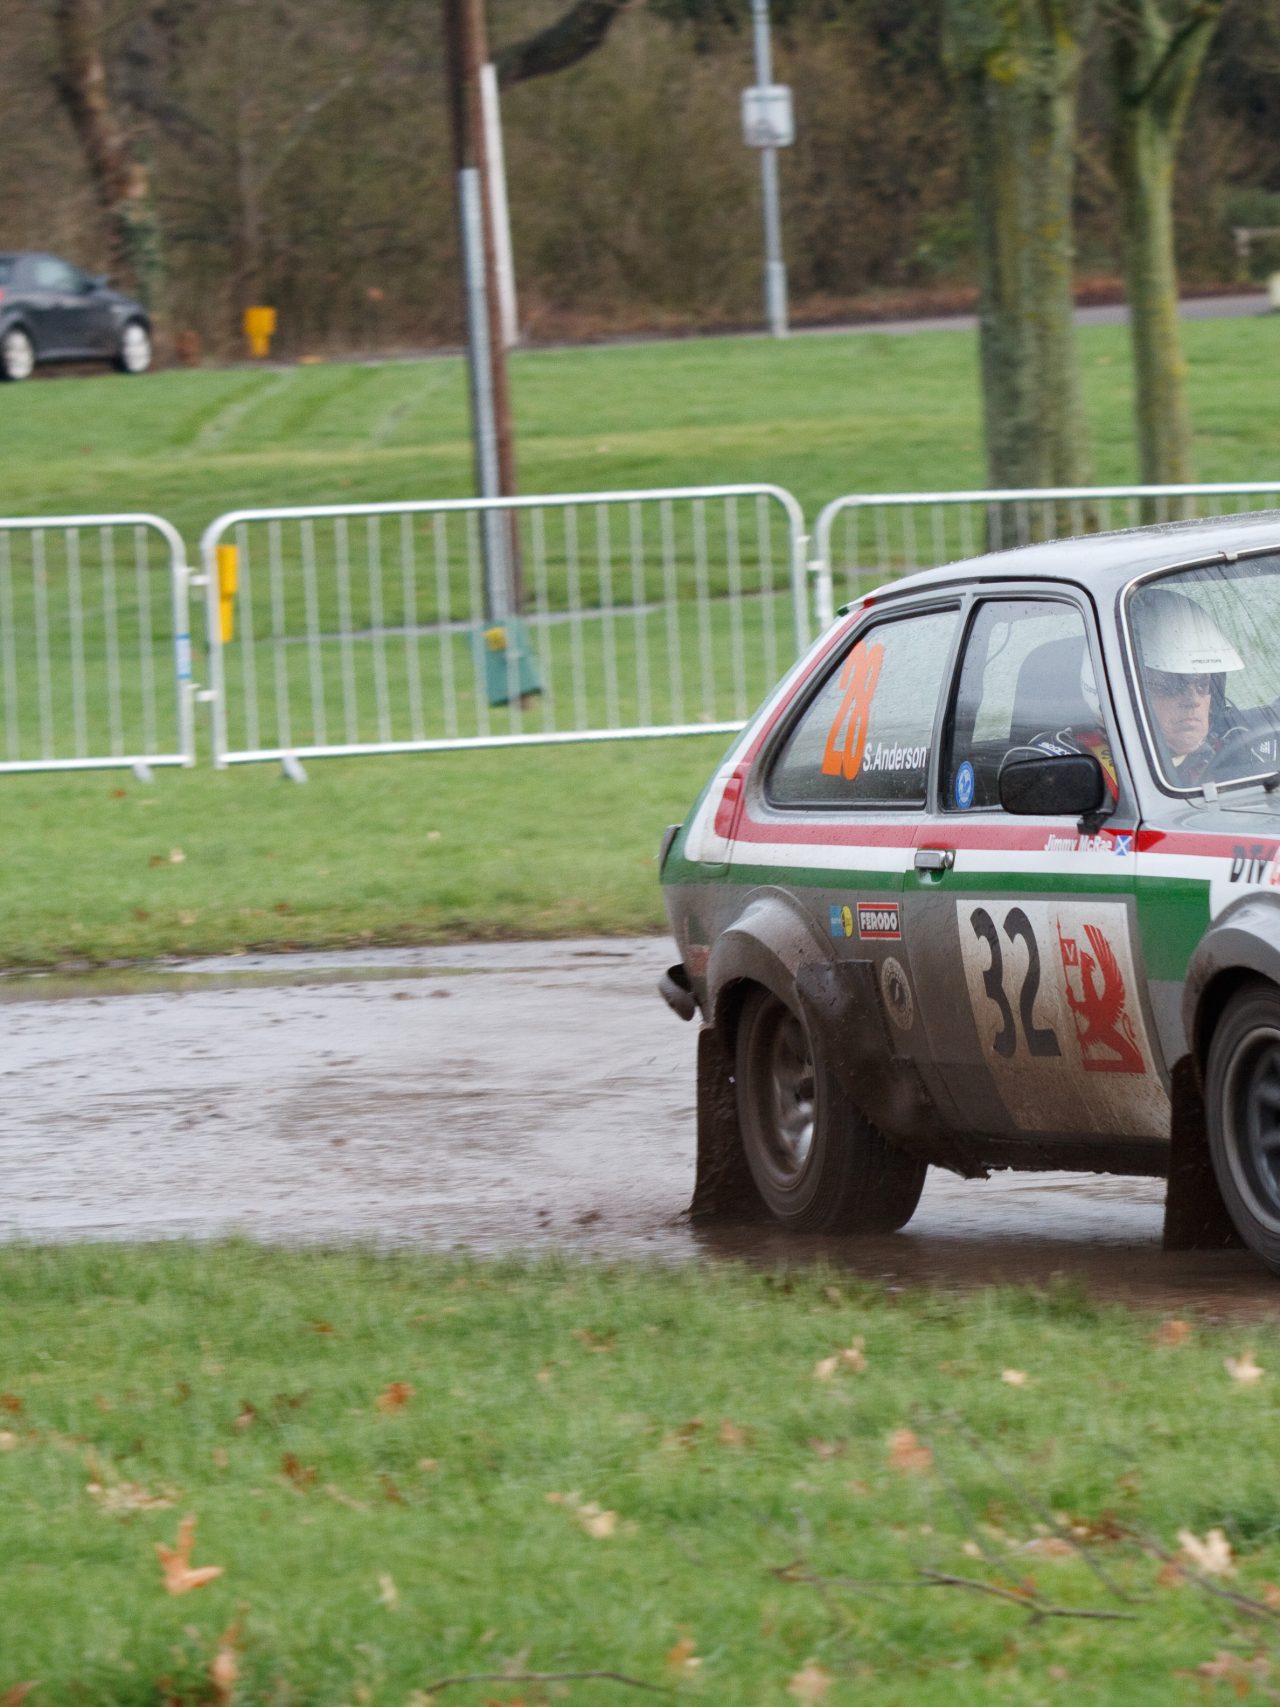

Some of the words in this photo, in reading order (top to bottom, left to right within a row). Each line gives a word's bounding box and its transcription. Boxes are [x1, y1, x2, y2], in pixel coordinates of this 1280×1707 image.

[821, 638, 886, 780] 28
[862, 742, 927, 772] S.Anderson
[1044, 833, 1078, 852] Jimmy
[860, 911, 898, 931] FERODO
[970, 907, 1062, 1058] 32
